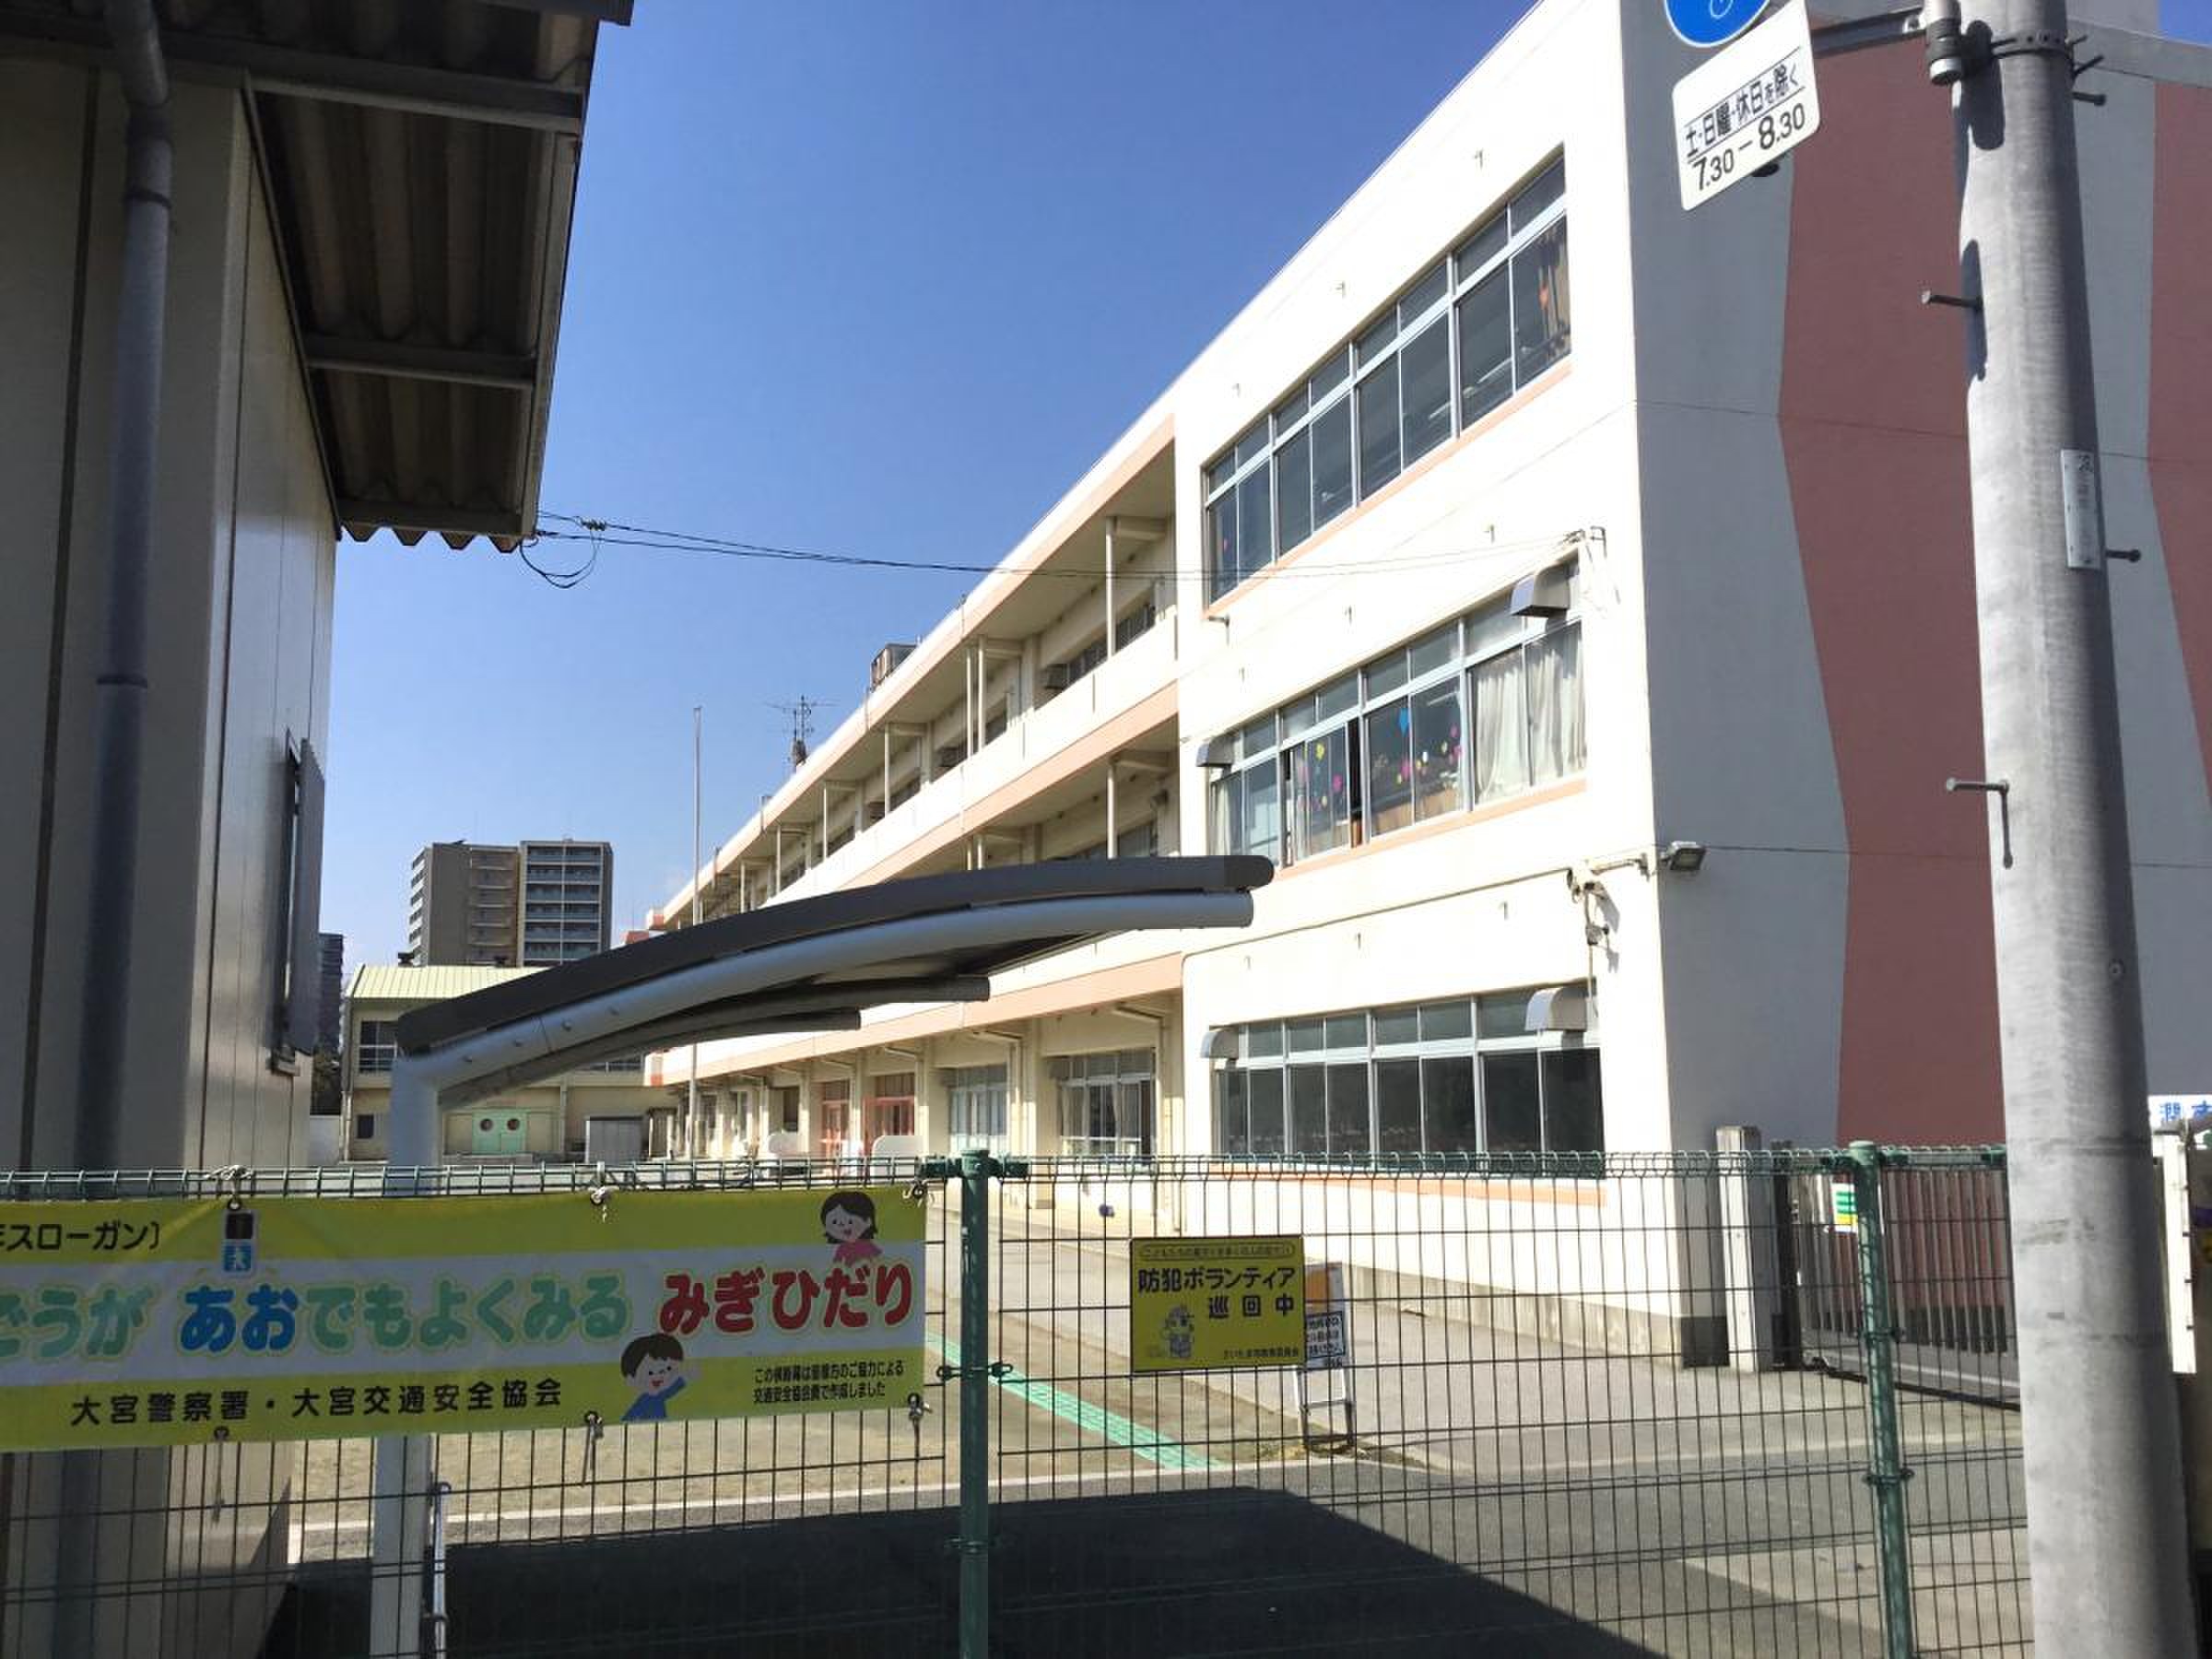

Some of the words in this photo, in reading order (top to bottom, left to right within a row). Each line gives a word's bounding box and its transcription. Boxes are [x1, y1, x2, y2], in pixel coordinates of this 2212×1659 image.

[1137, 1266, 1296, 1293] 防犯ボランティア
[658, 1263, 912, 1335] みぎひだり
[1208, 1293, 1294, 1319] 巡回中
